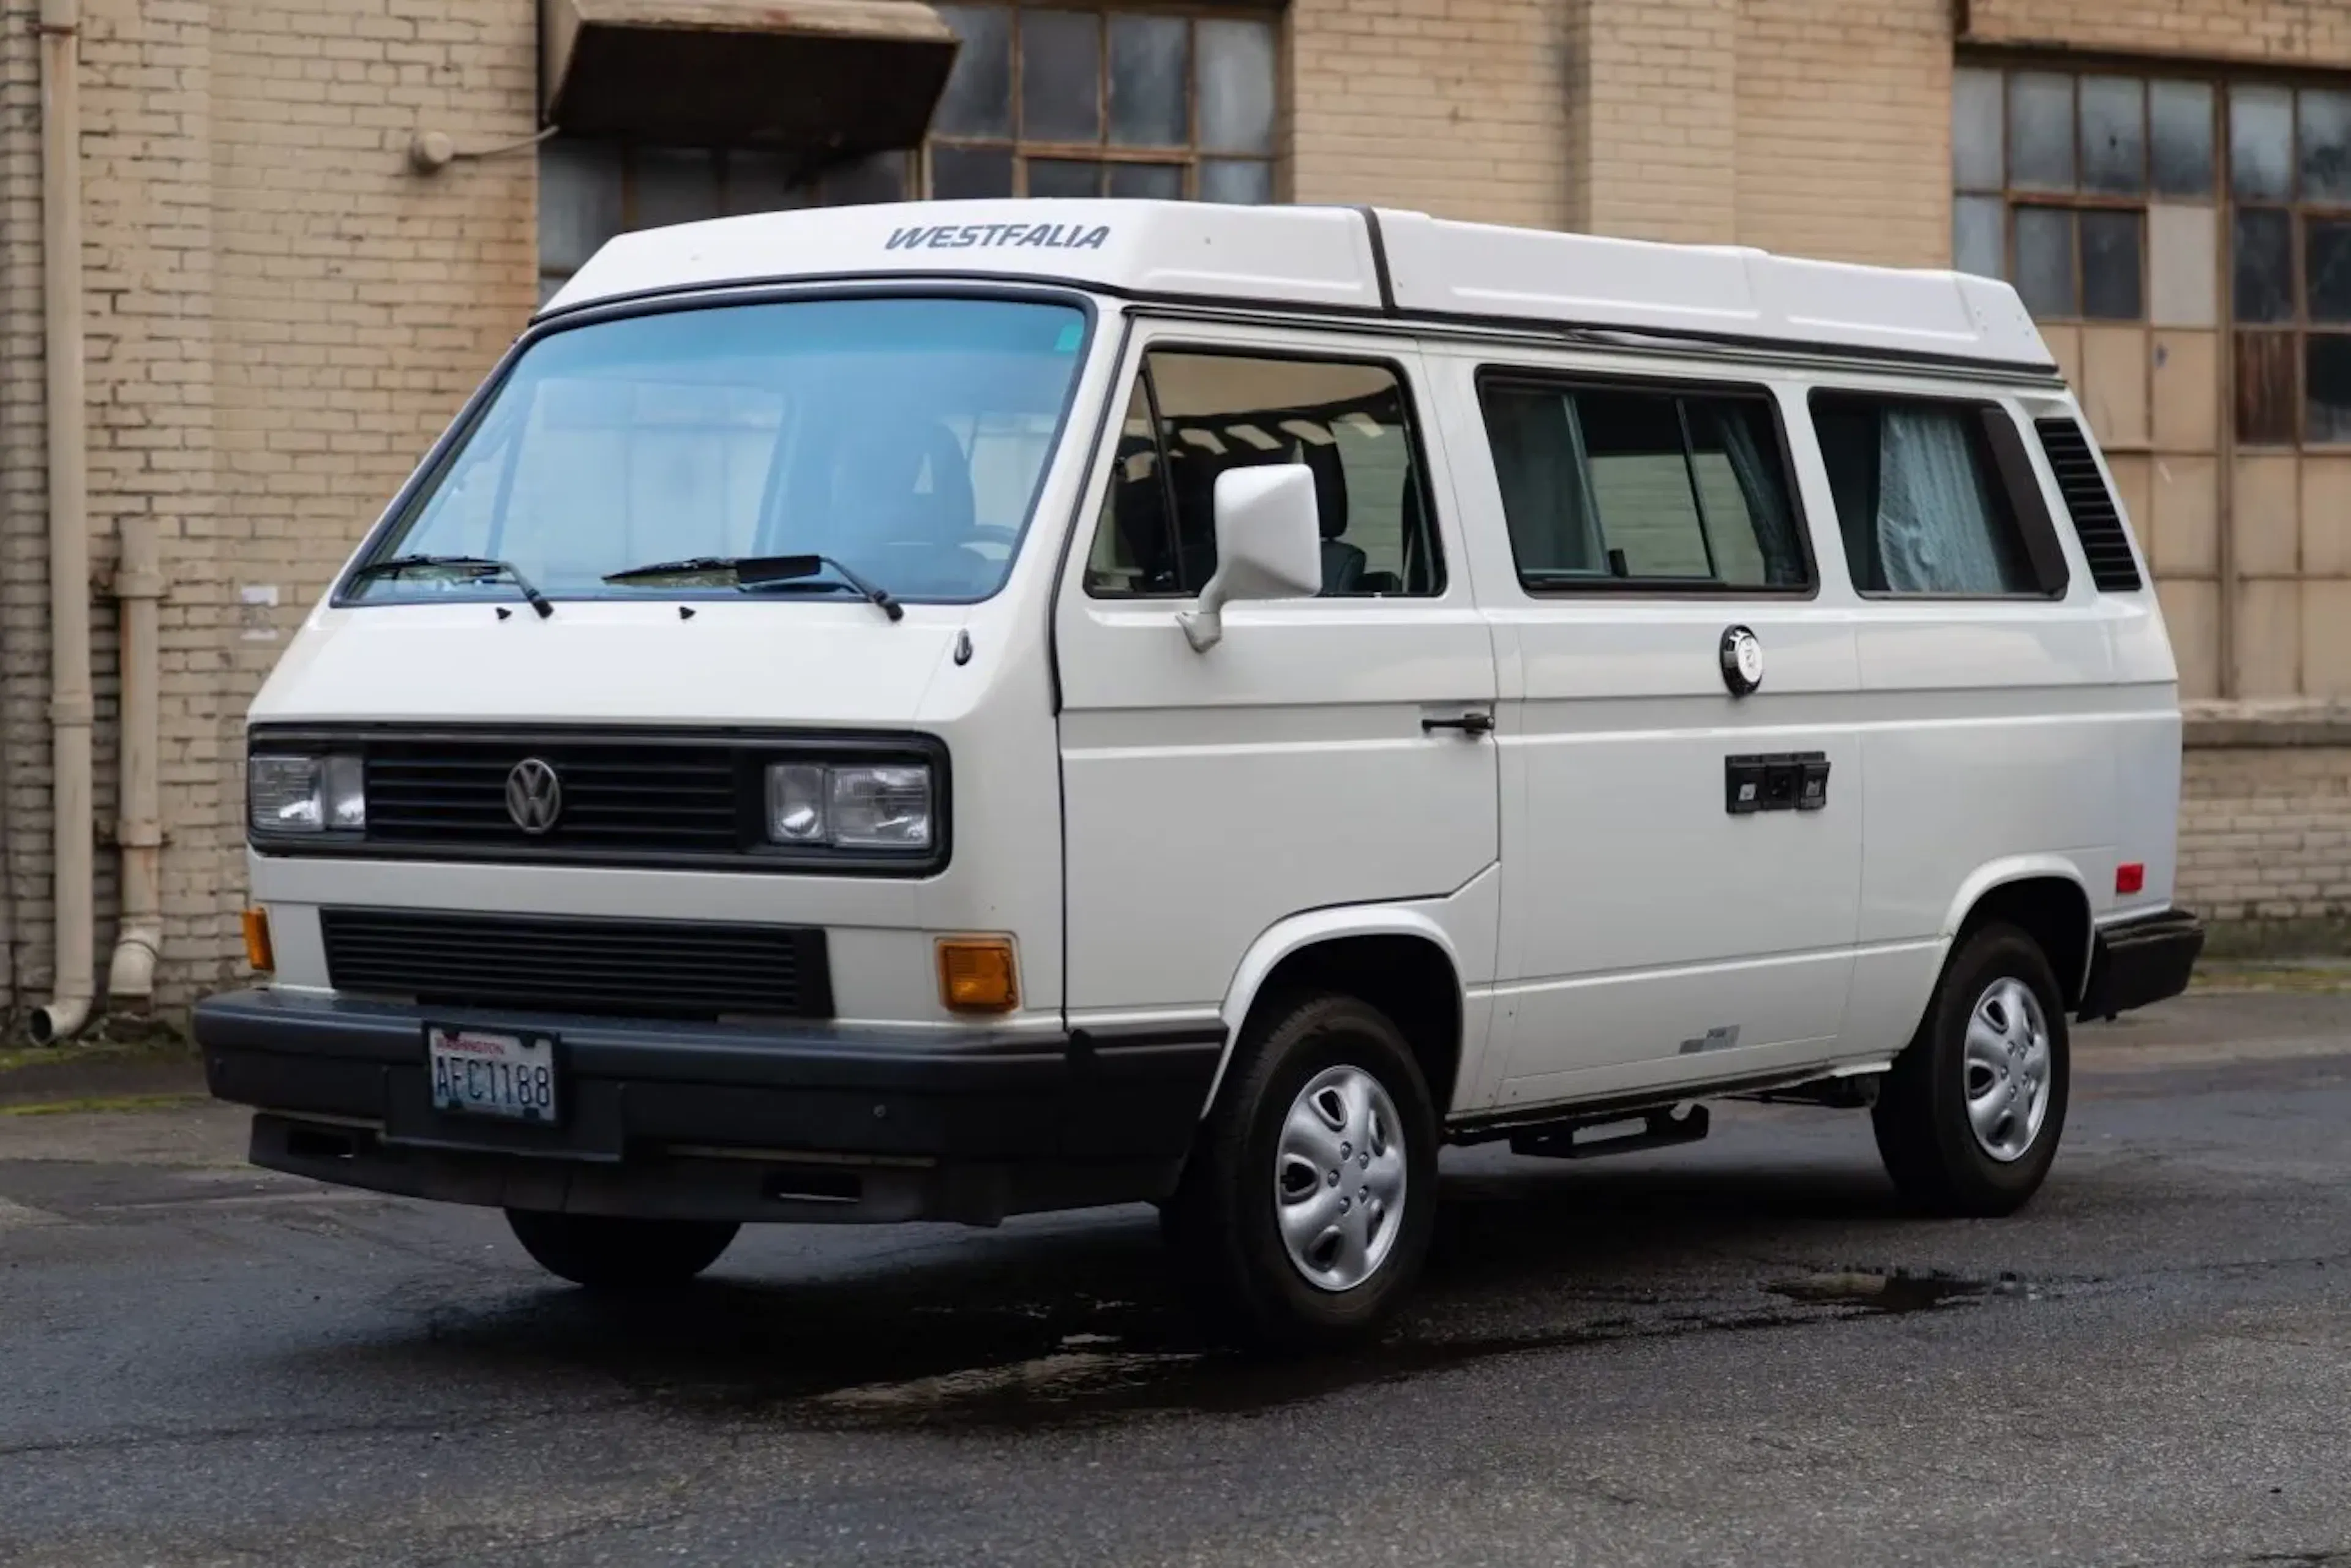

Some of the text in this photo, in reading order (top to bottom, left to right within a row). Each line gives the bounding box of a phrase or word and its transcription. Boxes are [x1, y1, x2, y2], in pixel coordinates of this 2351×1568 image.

[885, 224, 1110, 250] WESTFALIA
[507, 760, 560, 831] VW
[437, 1056, 550, 1106] AFC1188
